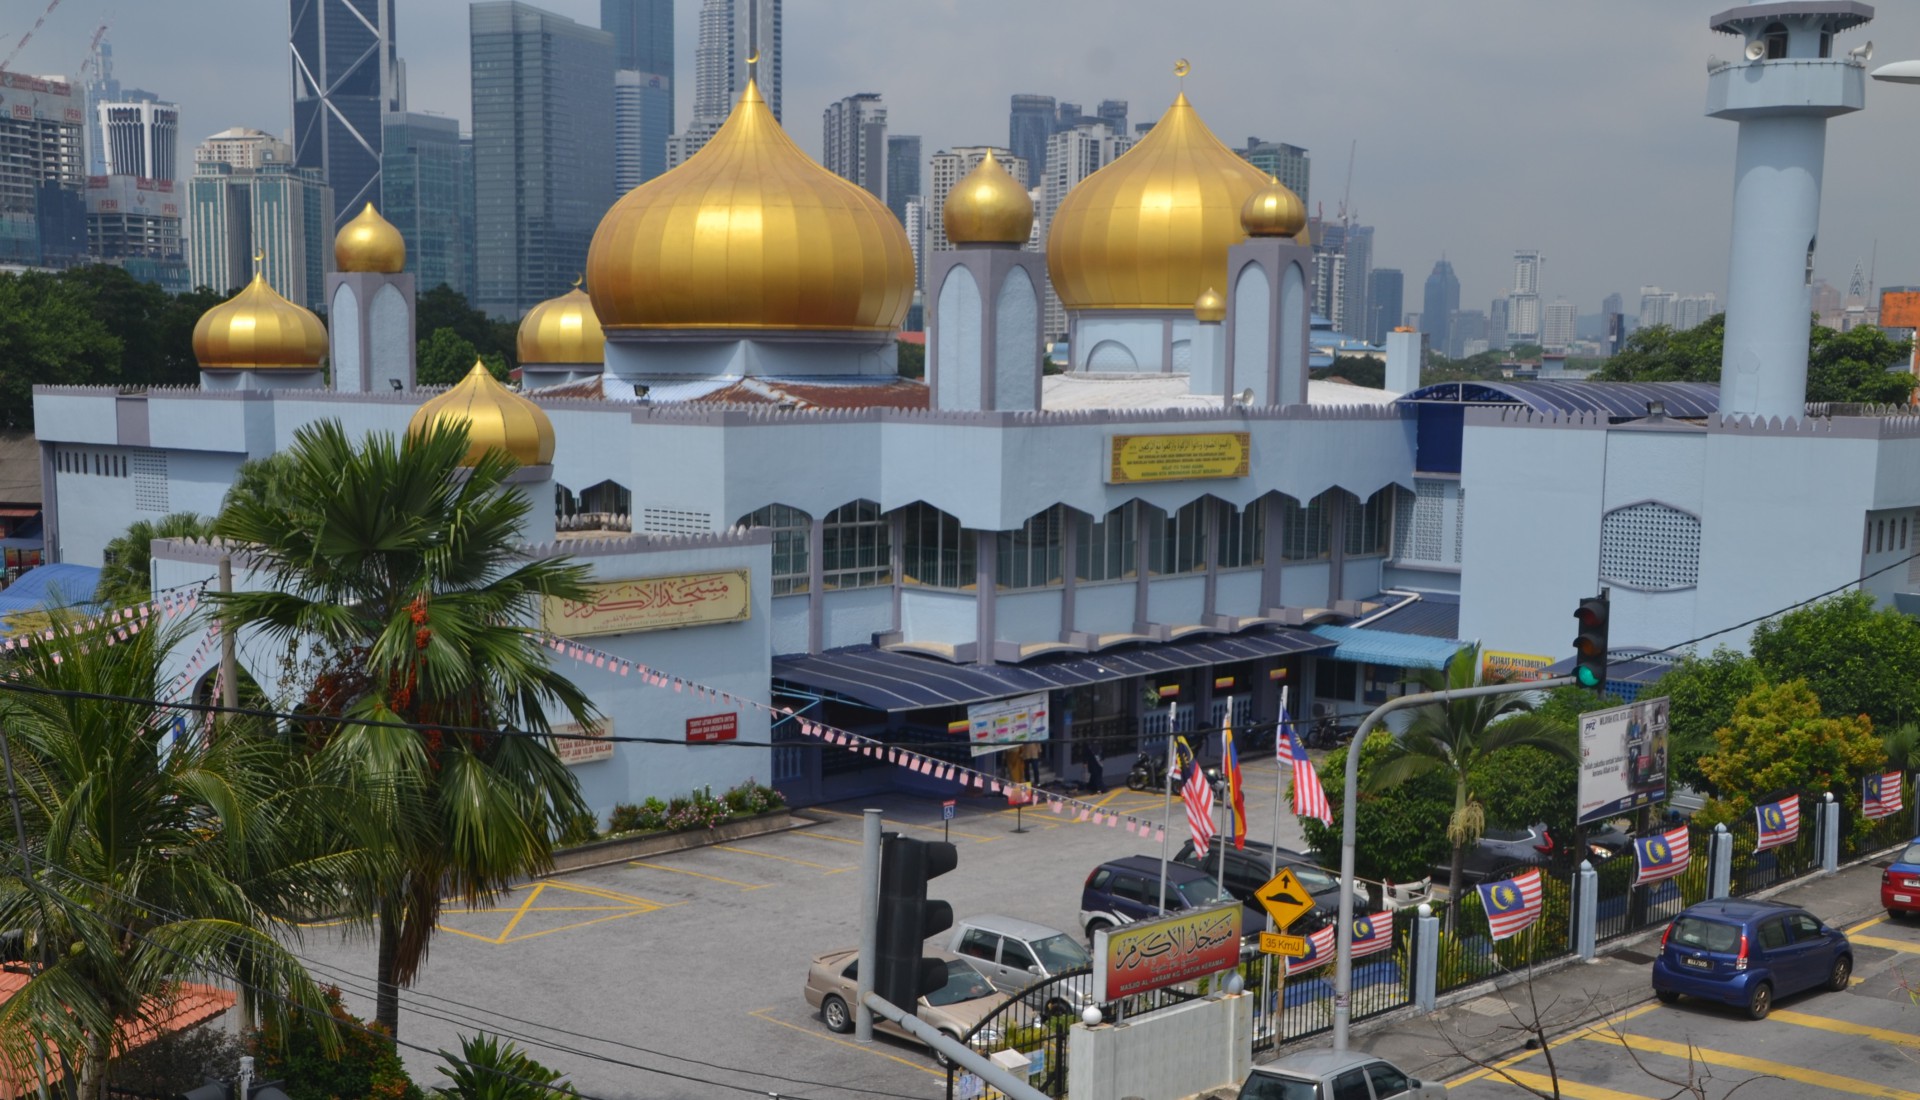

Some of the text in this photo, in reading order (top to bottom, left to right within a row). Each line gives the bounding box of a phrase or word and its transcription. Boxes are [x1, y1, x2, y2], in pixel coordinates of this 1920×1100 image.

[15, 104, 32, 116] PERI
[66, 108, 82, 119] PERI
[101, 199, 118, 209] PERI
[572, 748, 582, 756] JAM
[595, 744, 612, 753] MALAM
[1265, 938, 1300, 952] 35 Km/J
[1120, 981, 1141, 991] MASJID
[1201, 958, 1226, 970] KERAMAT
